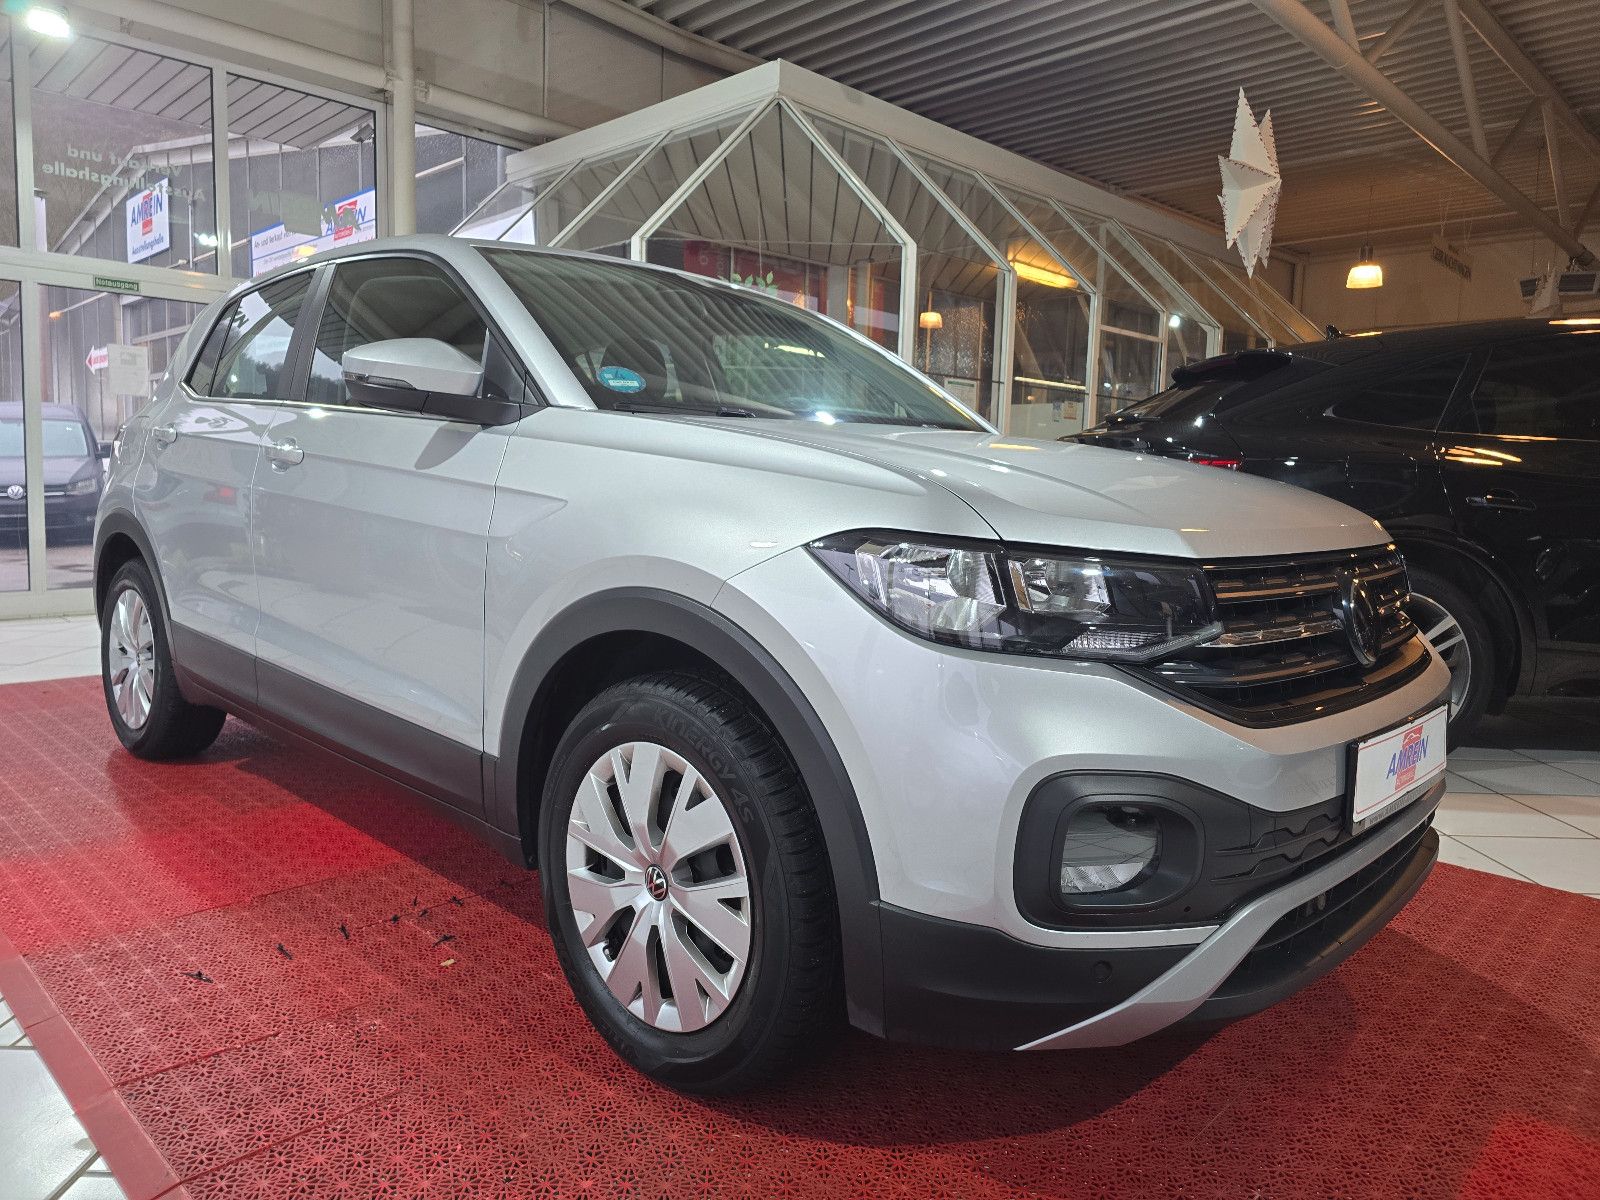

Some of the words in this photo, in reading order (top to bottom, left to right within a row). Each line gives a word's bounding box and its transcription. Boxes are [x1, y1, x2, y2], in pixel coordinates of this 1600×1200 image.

[131, 193, 163, 227] AMREIN
[96, 278, 138, 291] Notausgang
[1386, 735, 1429, 779] AMREIN
